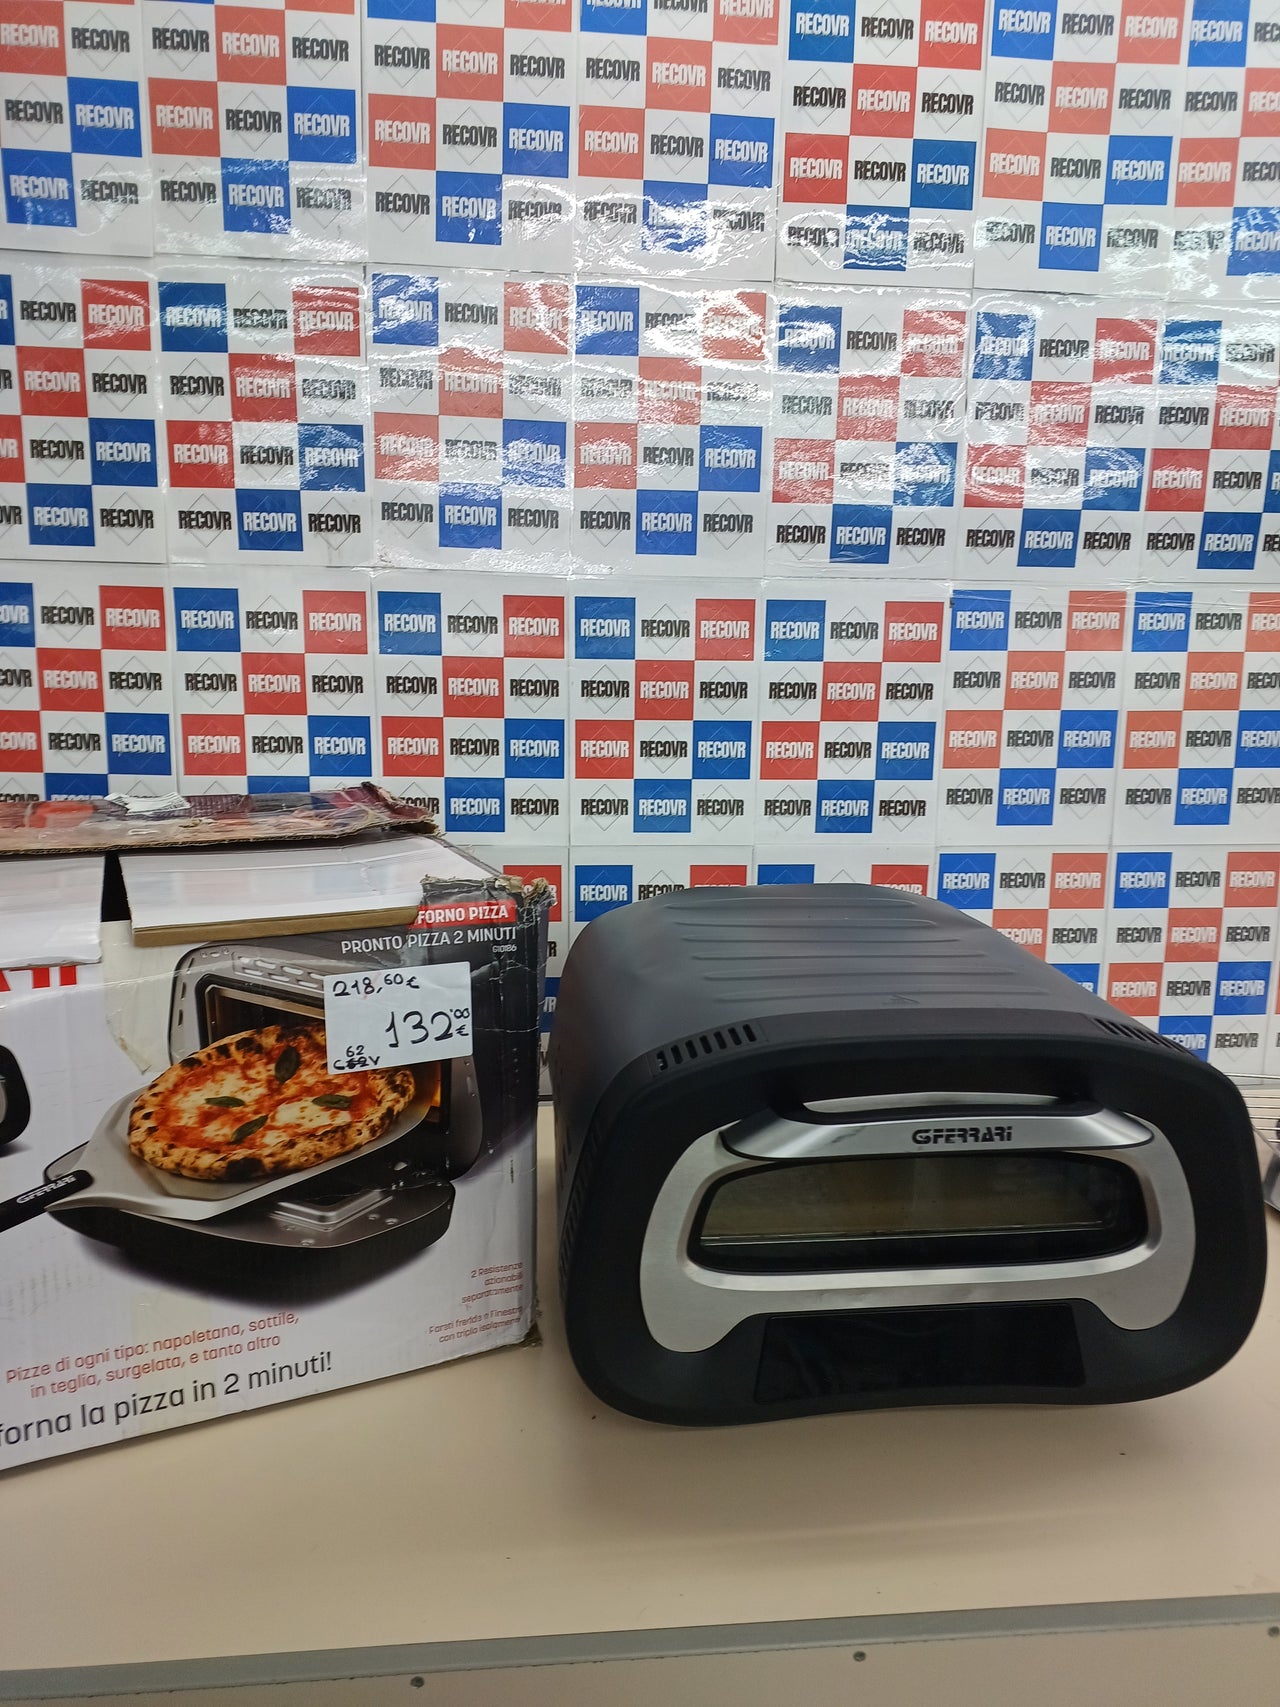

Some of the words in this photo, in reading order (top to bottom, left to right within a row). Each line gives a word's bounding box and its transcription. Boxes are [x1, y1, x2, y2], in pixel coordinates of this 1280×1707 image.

[796, 12, 849, 36] RECOVR
[861, 15, 914, 41] RECOVR
[998, 7, 1051, 36] RECOVR
[1061, 11, 1114, 37] RECOVR
[1125, 15, 1177, 41] RECOVR
[1190, 18, 1242, 44] RECOVR
[71, 27, 130, 53] RECOVR
[152, 27, 209, 53] RECOVR
[925, 20, 977, 46] RECOVR
[222, 32, 279, 58] RECOVR
[373, 44, 431, 70] RECOVR
[441, 49, 499, 75] RECOVR
[510, 55, 564, 79] RECOVR
[585, 58, 640, 81] RECOVR
[652, 62, 706, 88] RECOVR
[716, 67, 772, 92] RECOVR
[793, 86, 845, 109] RECOVR
[857, 88, 910, 112] RECOVR
[921, 92, 974, 116] RECOVR
[994, 81, 1045, 106] RECOVR
[1055, 85, 1107, 111] RECOVR
[1119, 88, 1171, 110] RECOVR
[1184, 91, 1238, 111] RECOVR
[4, 99, 63, 125] RECOVR
[75, 104, 134, 130] RECOVR
[156, 104, 213, 130] RECOVR
[225, 109, 282, 134] RECOVR
[293, 112, 350, 137] RECOVR
[373, 119, 431, 145] RECOVR
[442, 124, 497, 147] RECOVR
[508, 128, 563, 151] RECOVR
[584, 130, 638, 154] RECOVR
[649, 133, 705, 158] RECOVR
[714, 138, 767, 164] RECOVR
[790, 157, 842, 180] RECOVR
[853, 159, 906, 183] RECOVR
[916, 162, 969, 186] RECOVR
[989, 152, 1040, 177] RECOVR
[1050, 156, 1101, 181] RECOVR
[1112, 159, 1164, 181] RECOVR
[10, 174, 69, 200] RECOVR
[160, 180, 216, 205] RECOVR
[229, 183, 283, 208] RECOVR
[375, 191, 430, 214] RECOVR
[1045, 224, 1096, 249] RECOVR
[20, 300, 76, 322] RECOVR
[88, 304, 144, 326] RECOVR
[445, 302, 498, 325] RECOVR
[846, 330, 897, 353] RECOVR
[24, 369, 80, 394] RECOVR
[91, 372, 147, 395] RECOVR
[170, 375, 224, 397] RECOVR
[29, 439, 85, 460] RECOVR
[96, 441, 150, 463] RECOVR
[173, 443, 227, 465] RECOVR
[705, 448, 755, 469] RECOVR
[1212, 471, 1262, 489] RECOVR
[33, 506, 87, 528] RECOVR
[98, 508, 154, 529] RECOVR
[243, 512, 296, 532] RECOVR
[381, 502, 433, 523] RECOVR
[580, 510, 630, 532] RECOVR
[642, 513, 692, 532] RECOVR
[776, 525, 826, 544] RECOVR
[837, 527, 885, 545] RECOVR
[966, 528, 1015, 548] RECOVR
[1083, 532, 1131, 550] RECOVR
[1205, 533, 1253, 552] RECOVR
[39, 605, 95, 626] RECOVR
[180, 609, 234, 629] RECOVR
[309, 612, 361, 633] RECOVR
[448, 615, 498, 635] RECOVR
[956, 610, 1004, 629] RECOVR
[1072, 611, 1120, 630] RECOVR
[1196, 612, 1242, 630] RECOVR
[579, 618, 630, 637] RECOVR
[889, 622, 937, 641] RECOVR
[108, 671, 162, 691] RECOVR
[248, 673, 300, 694] RECOVR
[386, 676, 437, 695] RECOVR
[640, 681, 689, 699] RECOVR
[953, 671, 1001, 688] RECOVR
[1011, 670, 1059, 689] RECOVR
[1135, 671, 1181, 689] RECOVR
[885, 682, 934, 700] RECOVR
[47, 732, 101, 752] RECOVR
[188, 734, 240, 755] RECOVR
[314, 737, 366, 755] RECOVR
[450, 738, 499, 756] RECOVR
[580, 740, 629, 758] RECOVR
[1006, 730, 1054, 747] RECOVR
[1063, 730, 1111, 747] RECOVR
[1130, 730, 1176, 748] RECOVR
[882, 741, 929, 760] RECOVR
[450, 798, 500, 815] RECOVR
[580, 798, 629, 816] RECOVR
[1060, 787, 1106, 805] RECOVR
[1181, 787, 1227, 805] RECOVR
[697, 799, 744, 816] RECOVR
[821, 799, 869, 816] RECOVR
[943, 872, 989, 890] RECOVR
[1175, 871, 1221, 887] RECOVR
[580, 885, 628, 900] RECOVR
[417, 907, 465, 924] FORNO
[469, 905, 509, 921] PIZZA
[341, 935, 402, 954] PRONTO
[406, 931, 450, 948] PIZZA
[453, 931, 464, 944] 2
[467, 927, 517, 943] MINUTI
[1052, 927, 1098, 943] RECOVR
[1167, 980, 1211, 997] RECOVR
[1215, 1033, 1259, 1048] RECOVR
[6, 1363, 51, 1384] Pizze
[55, 1356, 70, 1373] di
[74, 1348, 110, 1369] ogni
[114, 1343, 149, 1361] tipo:
[153, 1324, 245, 1352] napoletana,
[248, 1311, 299, 1332] sottile,
[30, 1384, 46, 1399] in
[50, 1372, 102, 1394] teglia,
[106, 1356, 185, 1380] surgelata,
[189, 1352, 199, 1364] e
[203, 1343, 243, 1361] tanto
[246, 1335, 281, 1352] altro
[81, 1404, 105, 1428] la
[114, 1388, 184, 1426] pizza
[192, 1380, 216, 1402] in
[223, 1373, 240, 1396] 2
[248, 1351, 332, 1390] minuti!
